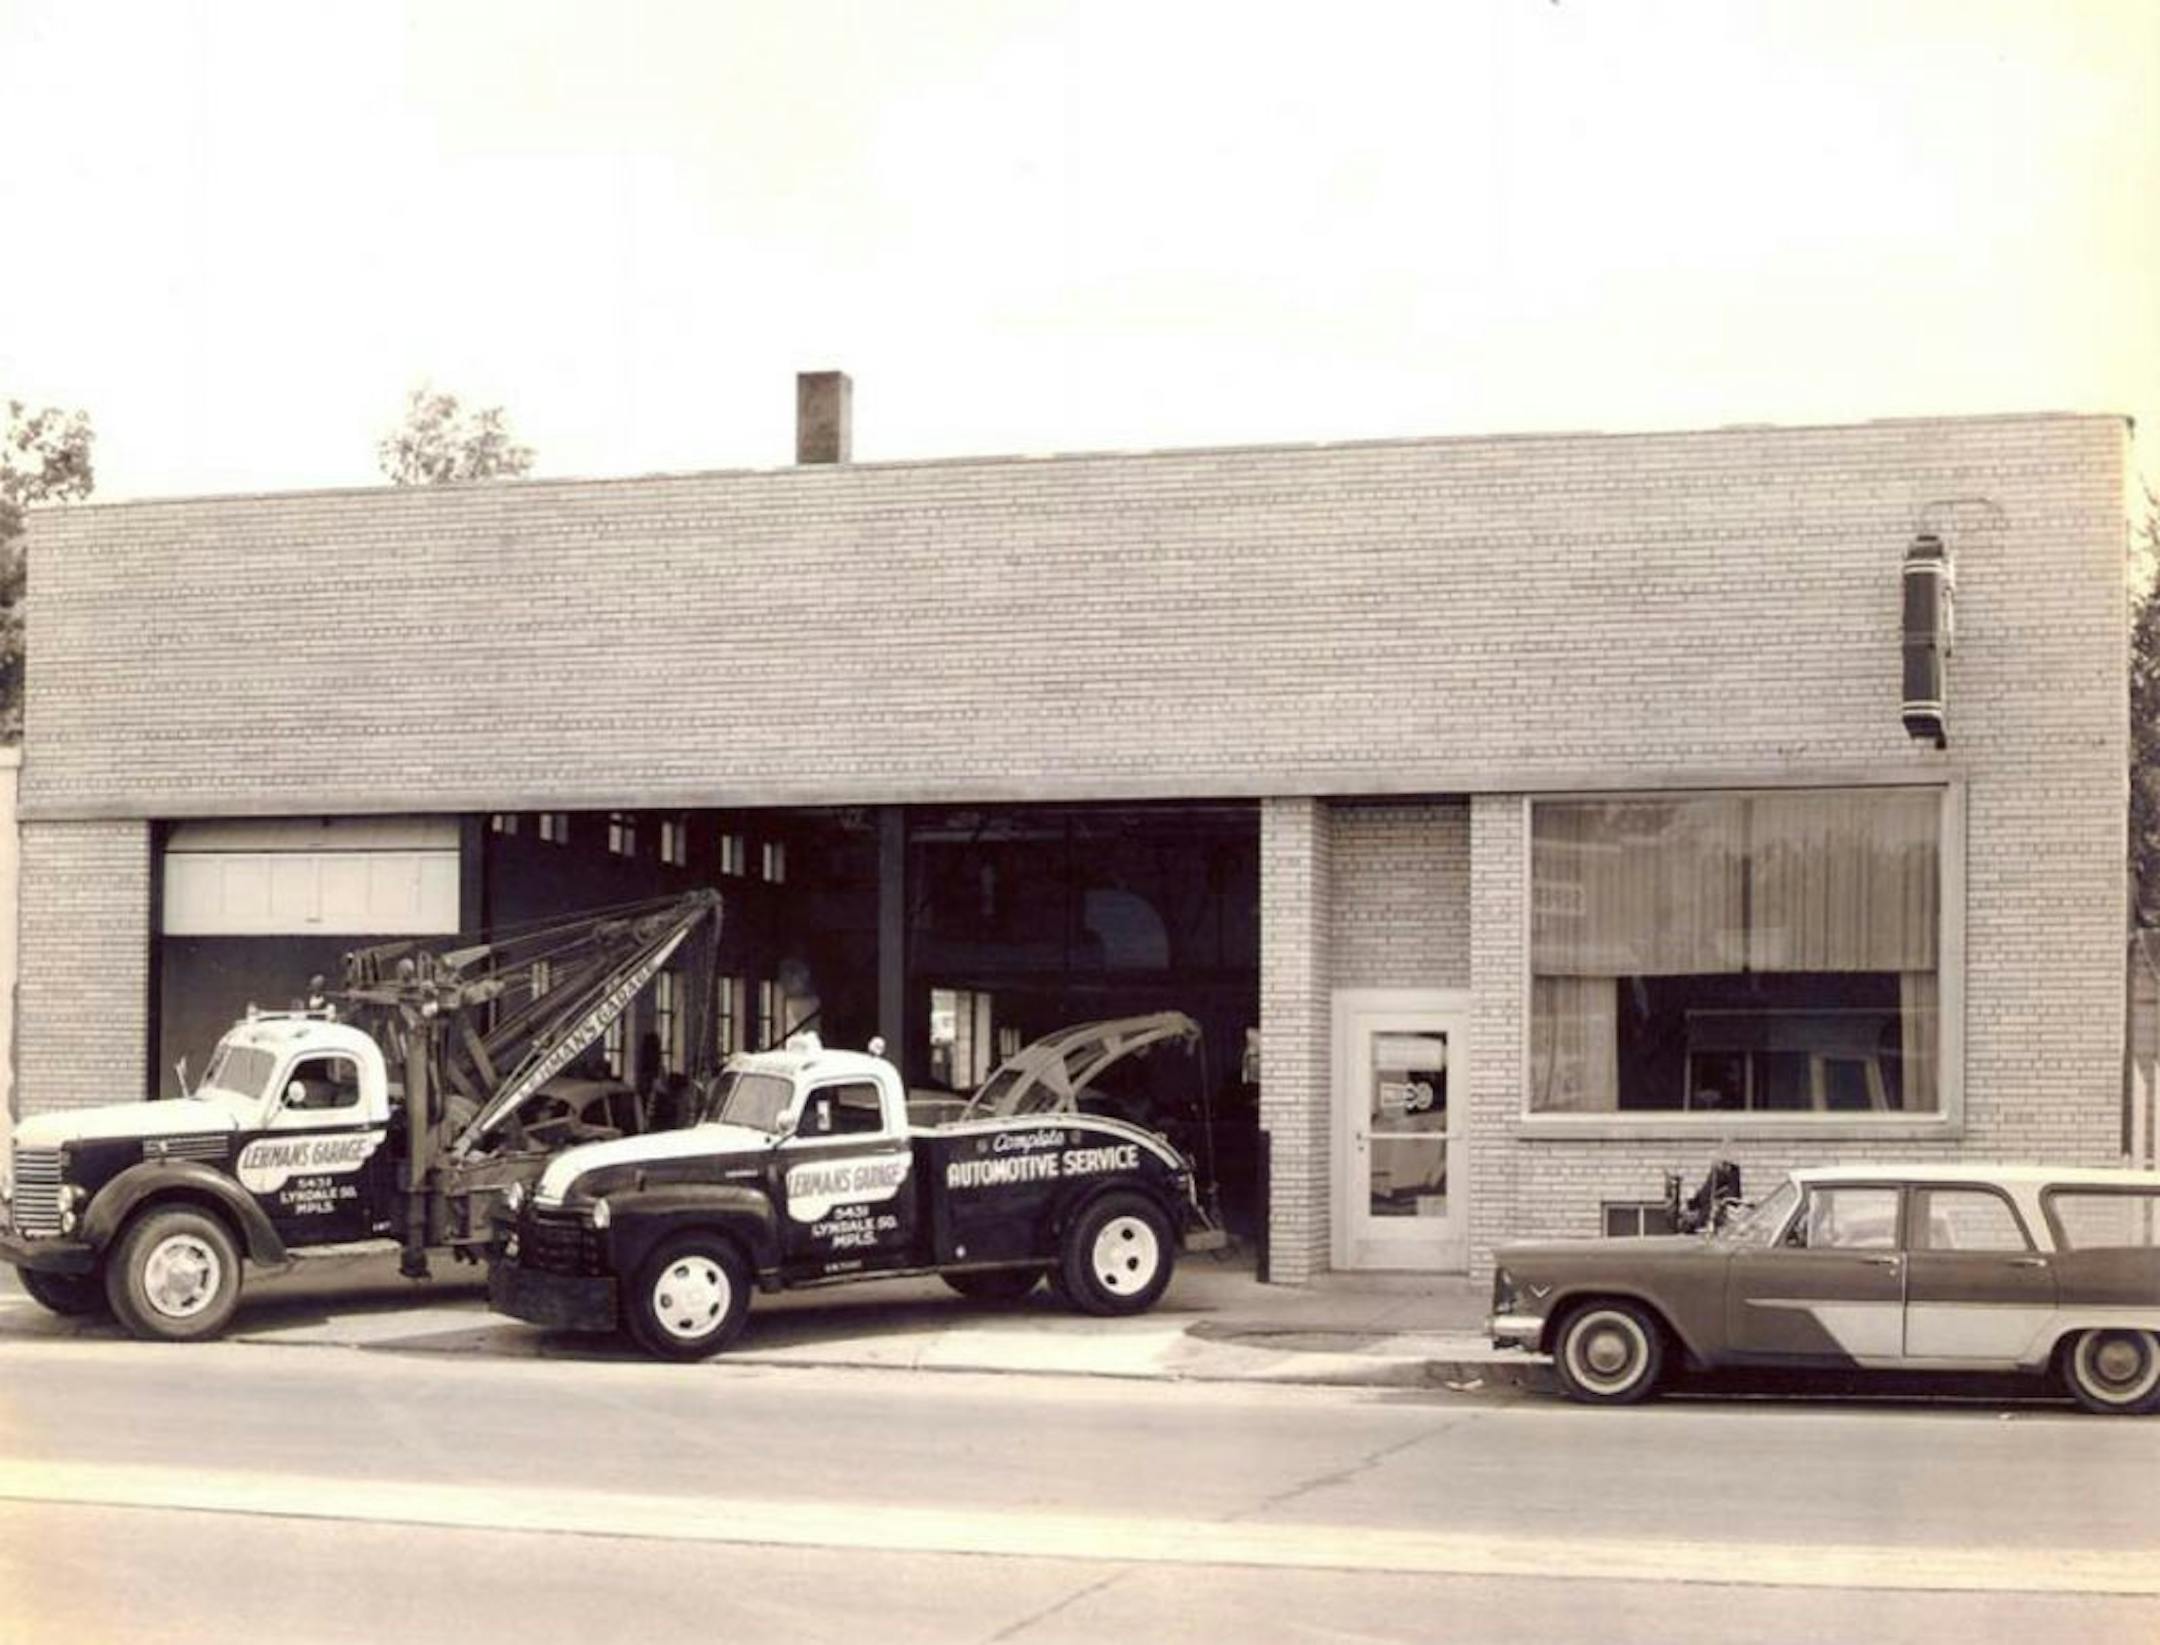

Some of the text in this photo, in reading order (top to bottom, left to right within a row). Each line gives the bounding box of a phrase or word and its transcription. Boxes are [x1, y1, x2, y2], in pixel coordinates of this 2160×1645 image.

[311, 1139, 367, 1165] GARAGE
[992, 1129, 1065, 1154] Complete
[946, 1145, 1141, 1188] AUTOMOTIVE SERVICE
